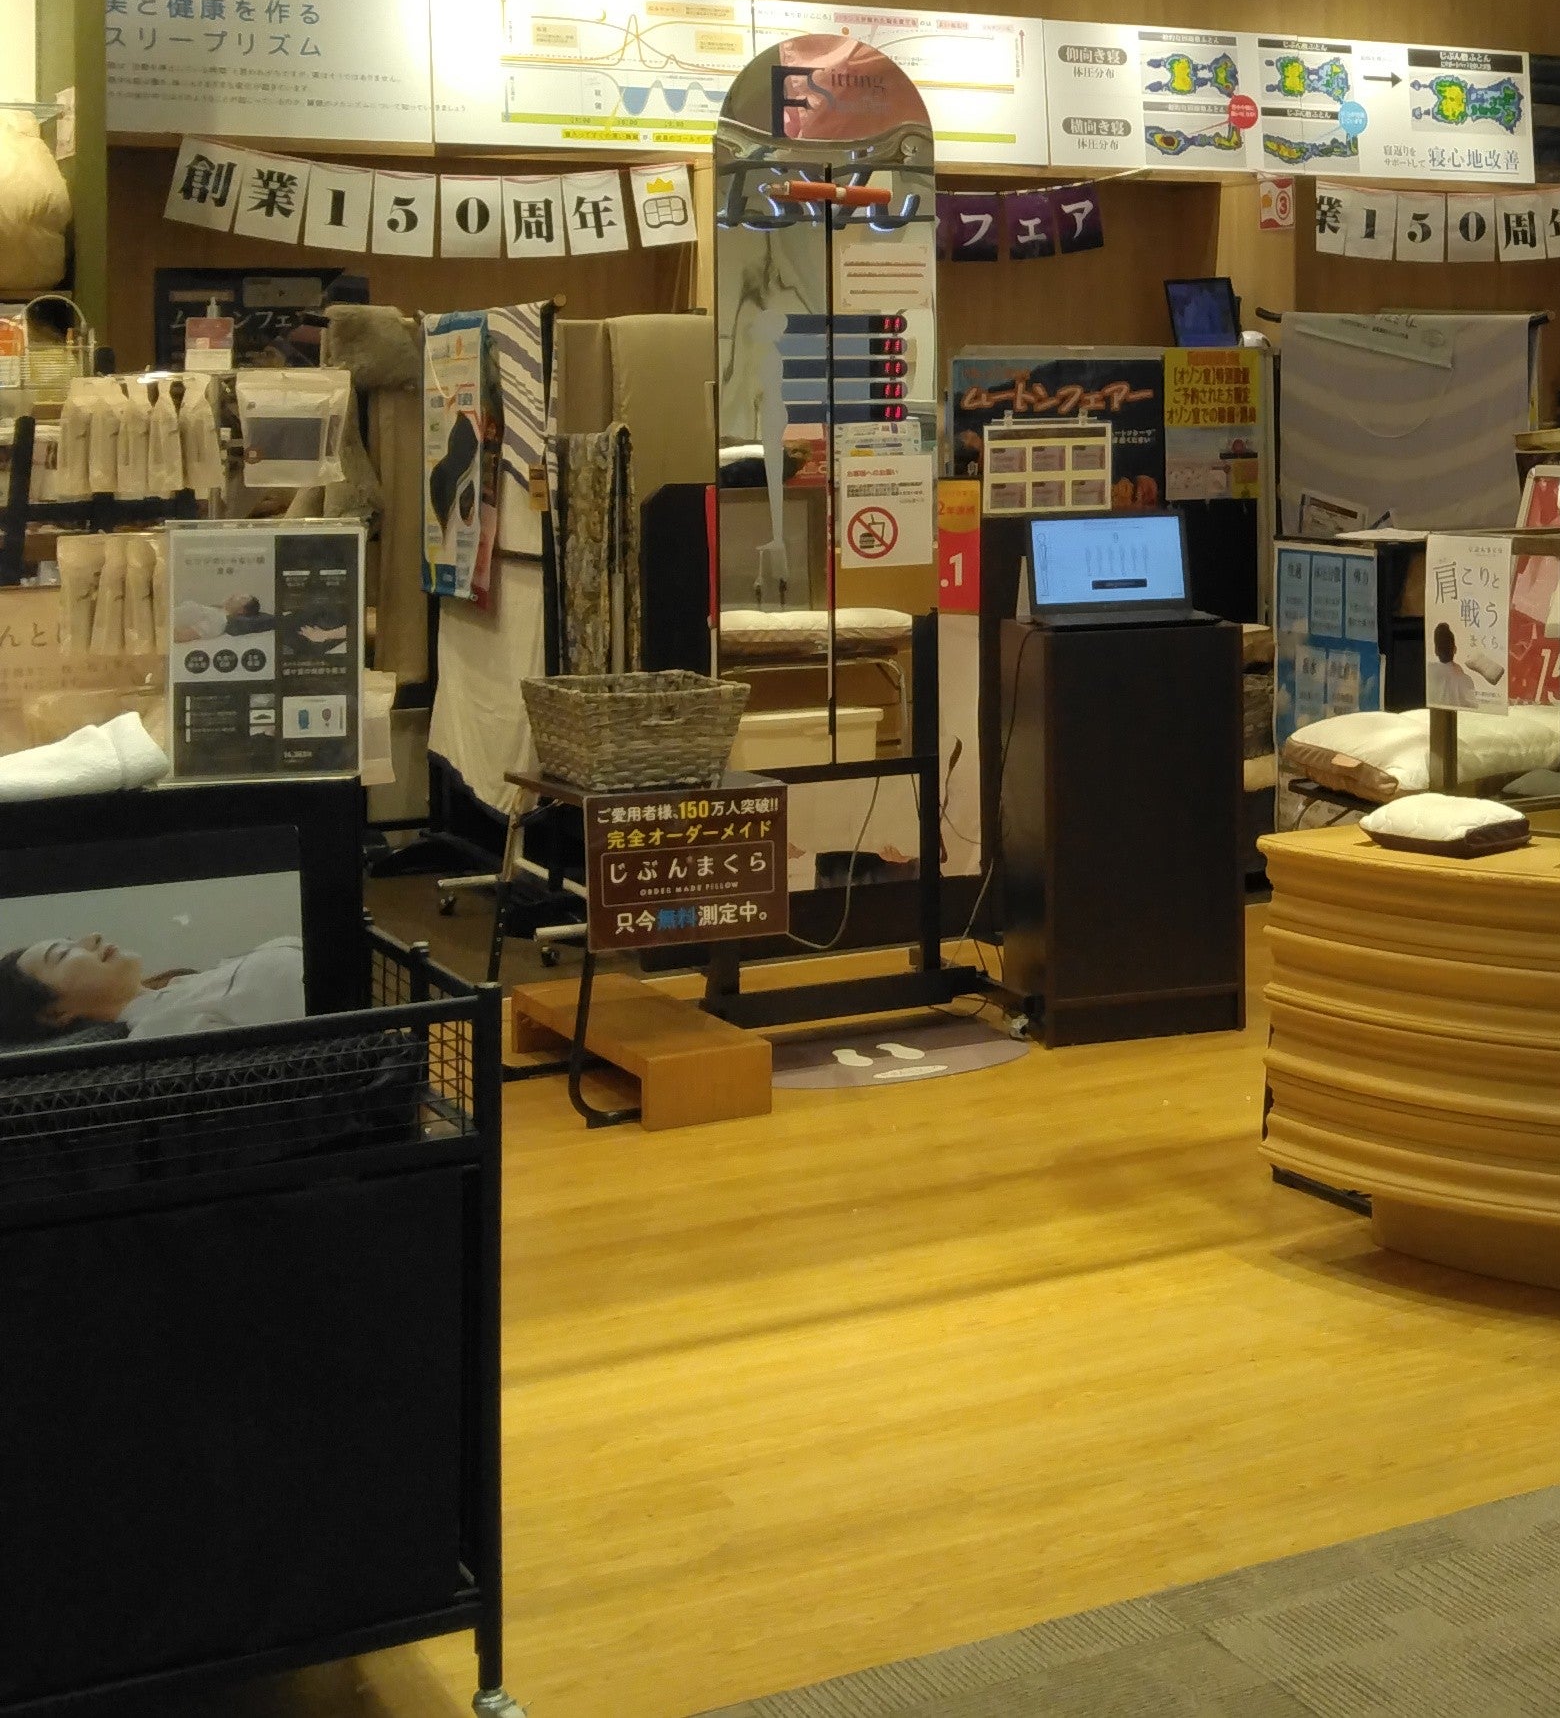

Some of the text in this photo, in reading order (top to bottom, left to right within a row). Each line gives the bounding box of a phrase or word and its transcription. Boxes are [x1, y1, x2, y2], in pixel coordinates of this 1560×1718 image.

[105, 27, 322, 58] スリープリズム
[1064, 45, 1124, 66] 仰向き寝
[1068, 117, 1126, 136] 横向き寝
[1428, 147, 1520, 171] 寝心地改善
[176, 153, 618, 246] 創業150周年
[936, 198, 1094, 248] フェア
[1432, 558, 1501, 605] 肩こりと
[1460, 598, 1499, 629] 戦う
[597, 797, 779, 824] ご愛用者様、150万人突破!!
[606, 819, 773, 850] 完全オーダーメイド
[609, 851, 768, 884] じぶんまくら
[614, 900, 768, 935] 只今無料測定中。
